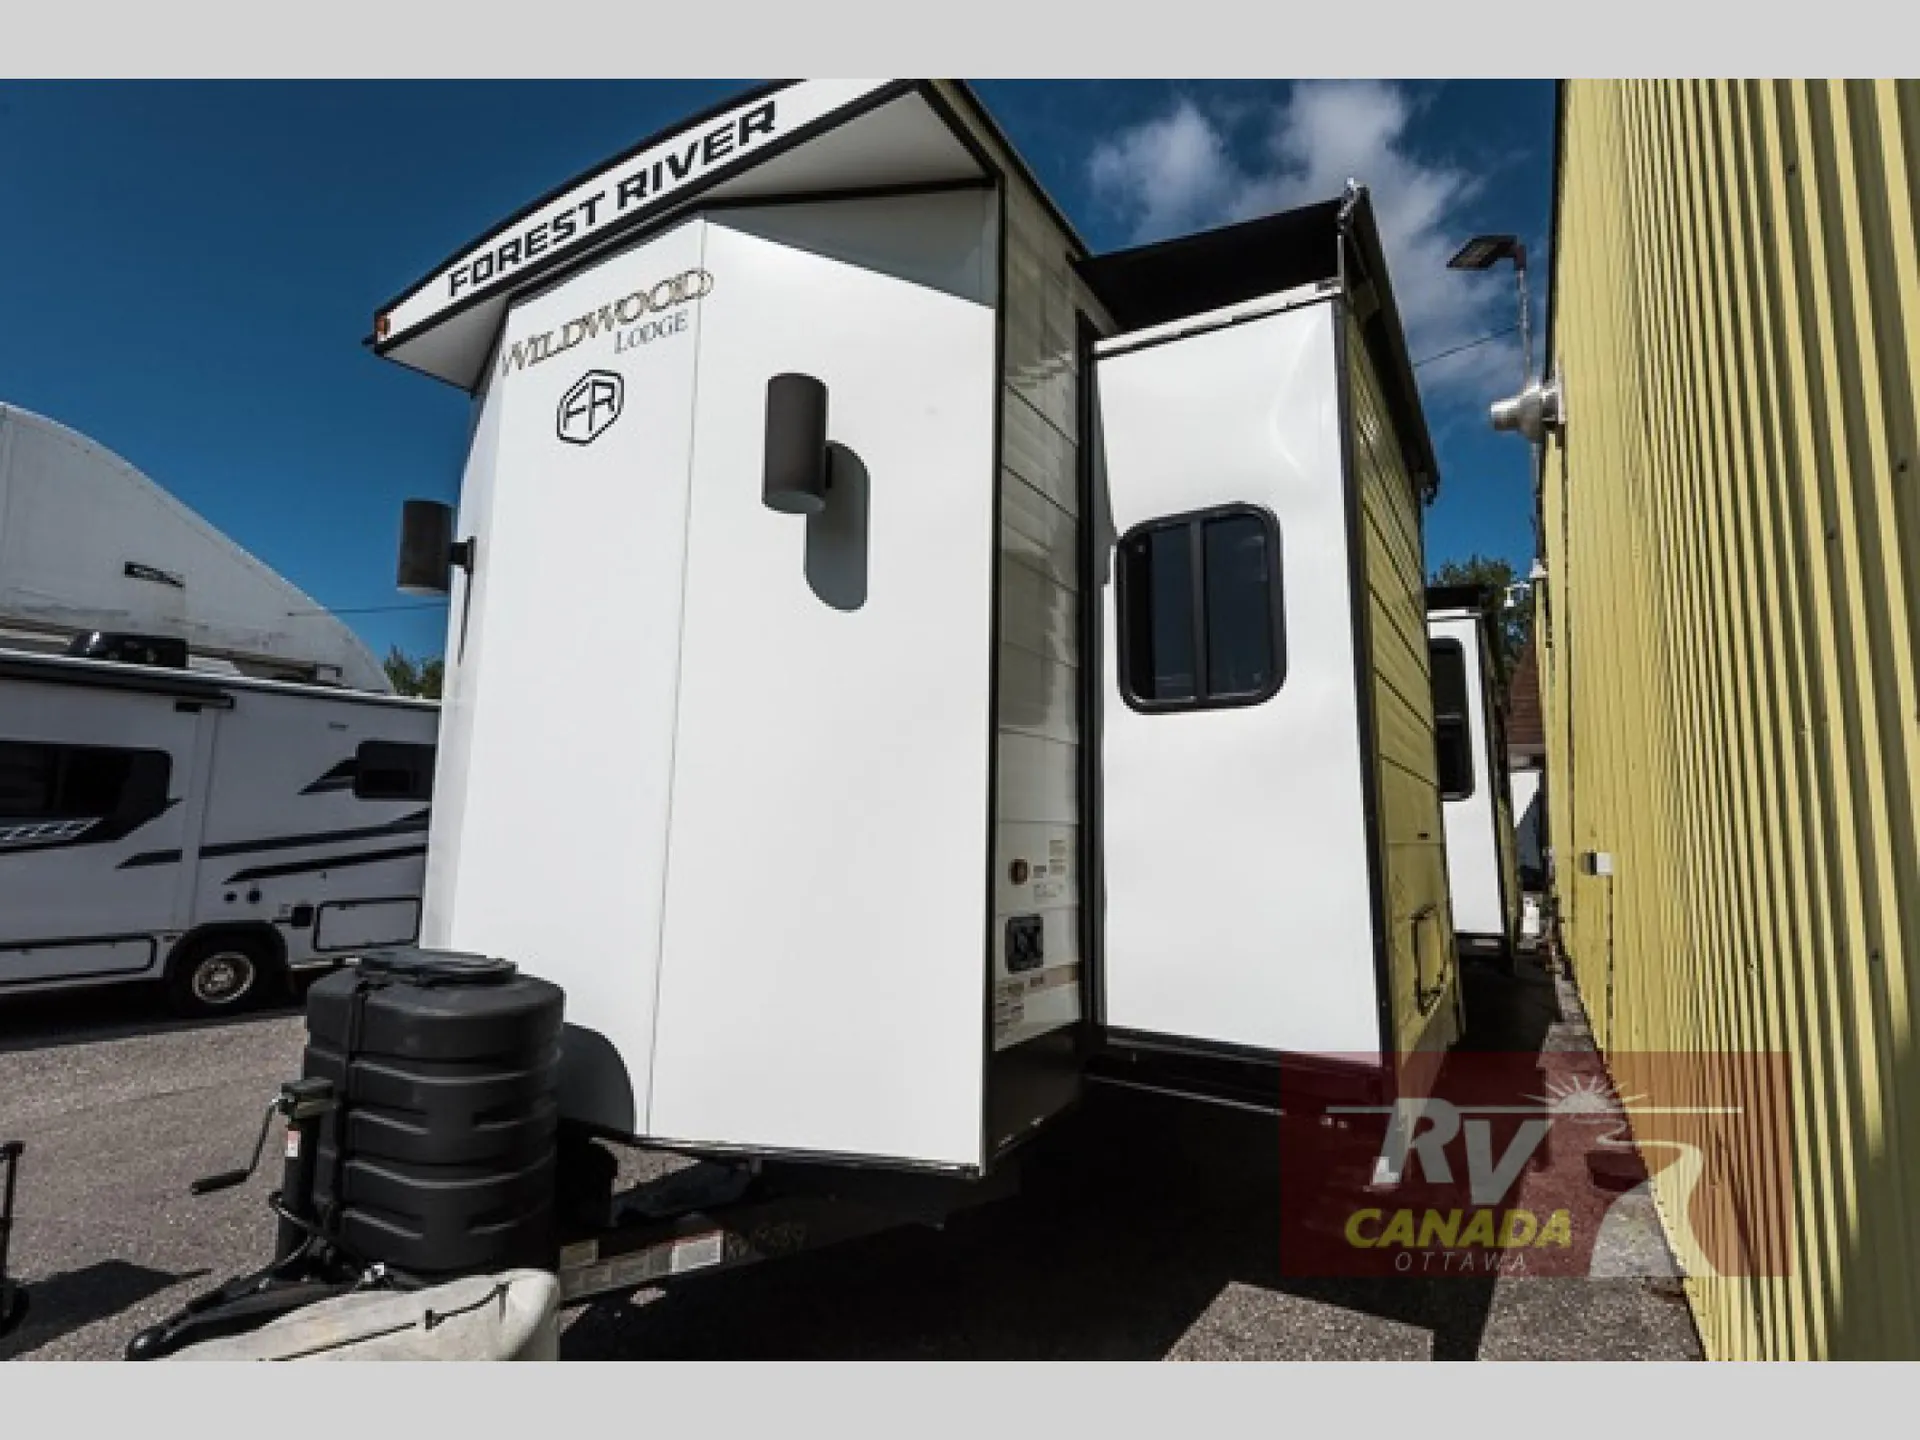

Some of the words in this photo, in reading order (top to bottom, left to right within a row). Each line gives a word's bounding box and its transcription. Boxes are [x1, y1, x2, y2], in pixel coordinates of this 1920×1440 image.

[448, 191, 606, 297] FOREST
[616, 101, 775, 210] RIVER
[501, 268, 713, 376] WILDWOOD
[614, 309, 688, 354] LODGE
